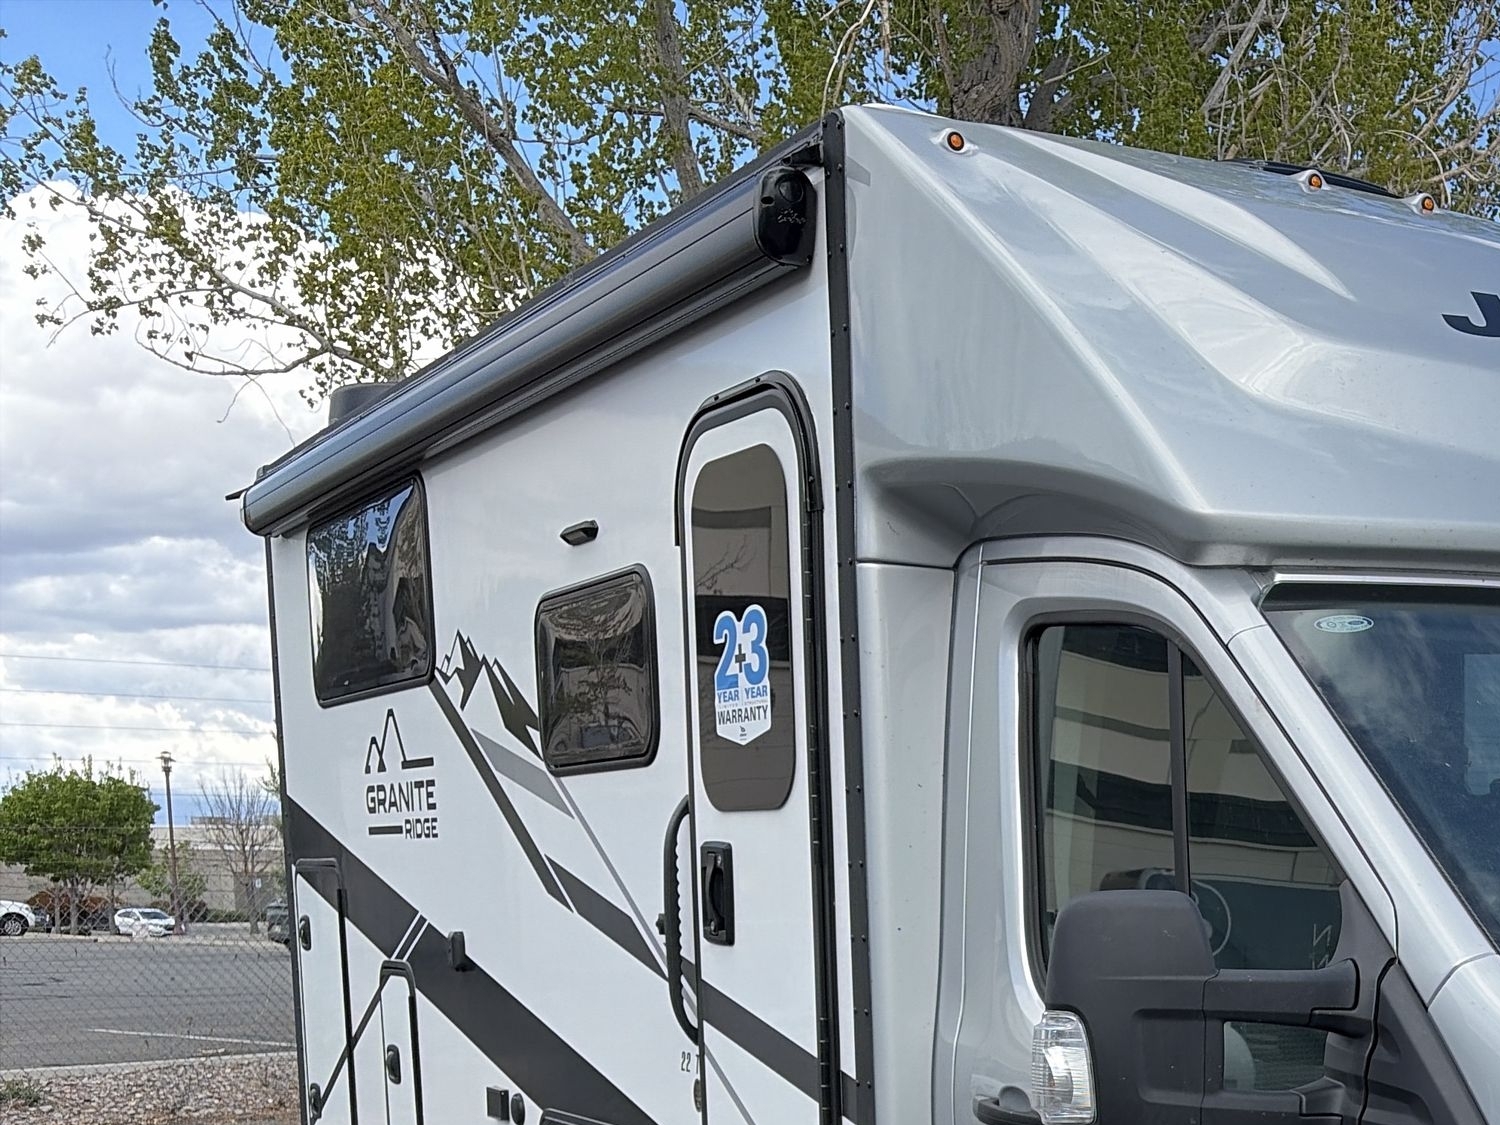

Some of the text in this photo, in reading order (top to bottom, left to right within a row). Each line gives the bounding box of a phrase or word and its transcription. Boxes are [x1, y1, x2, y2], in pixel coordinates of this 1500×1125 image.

[717, 685, 768, 704] YEAR YEAR
[717, 705, 768, 726] WARRANTY
[366, 779, 437, 814] GRANITE
[404, 817, 439, 839] RIDGE
